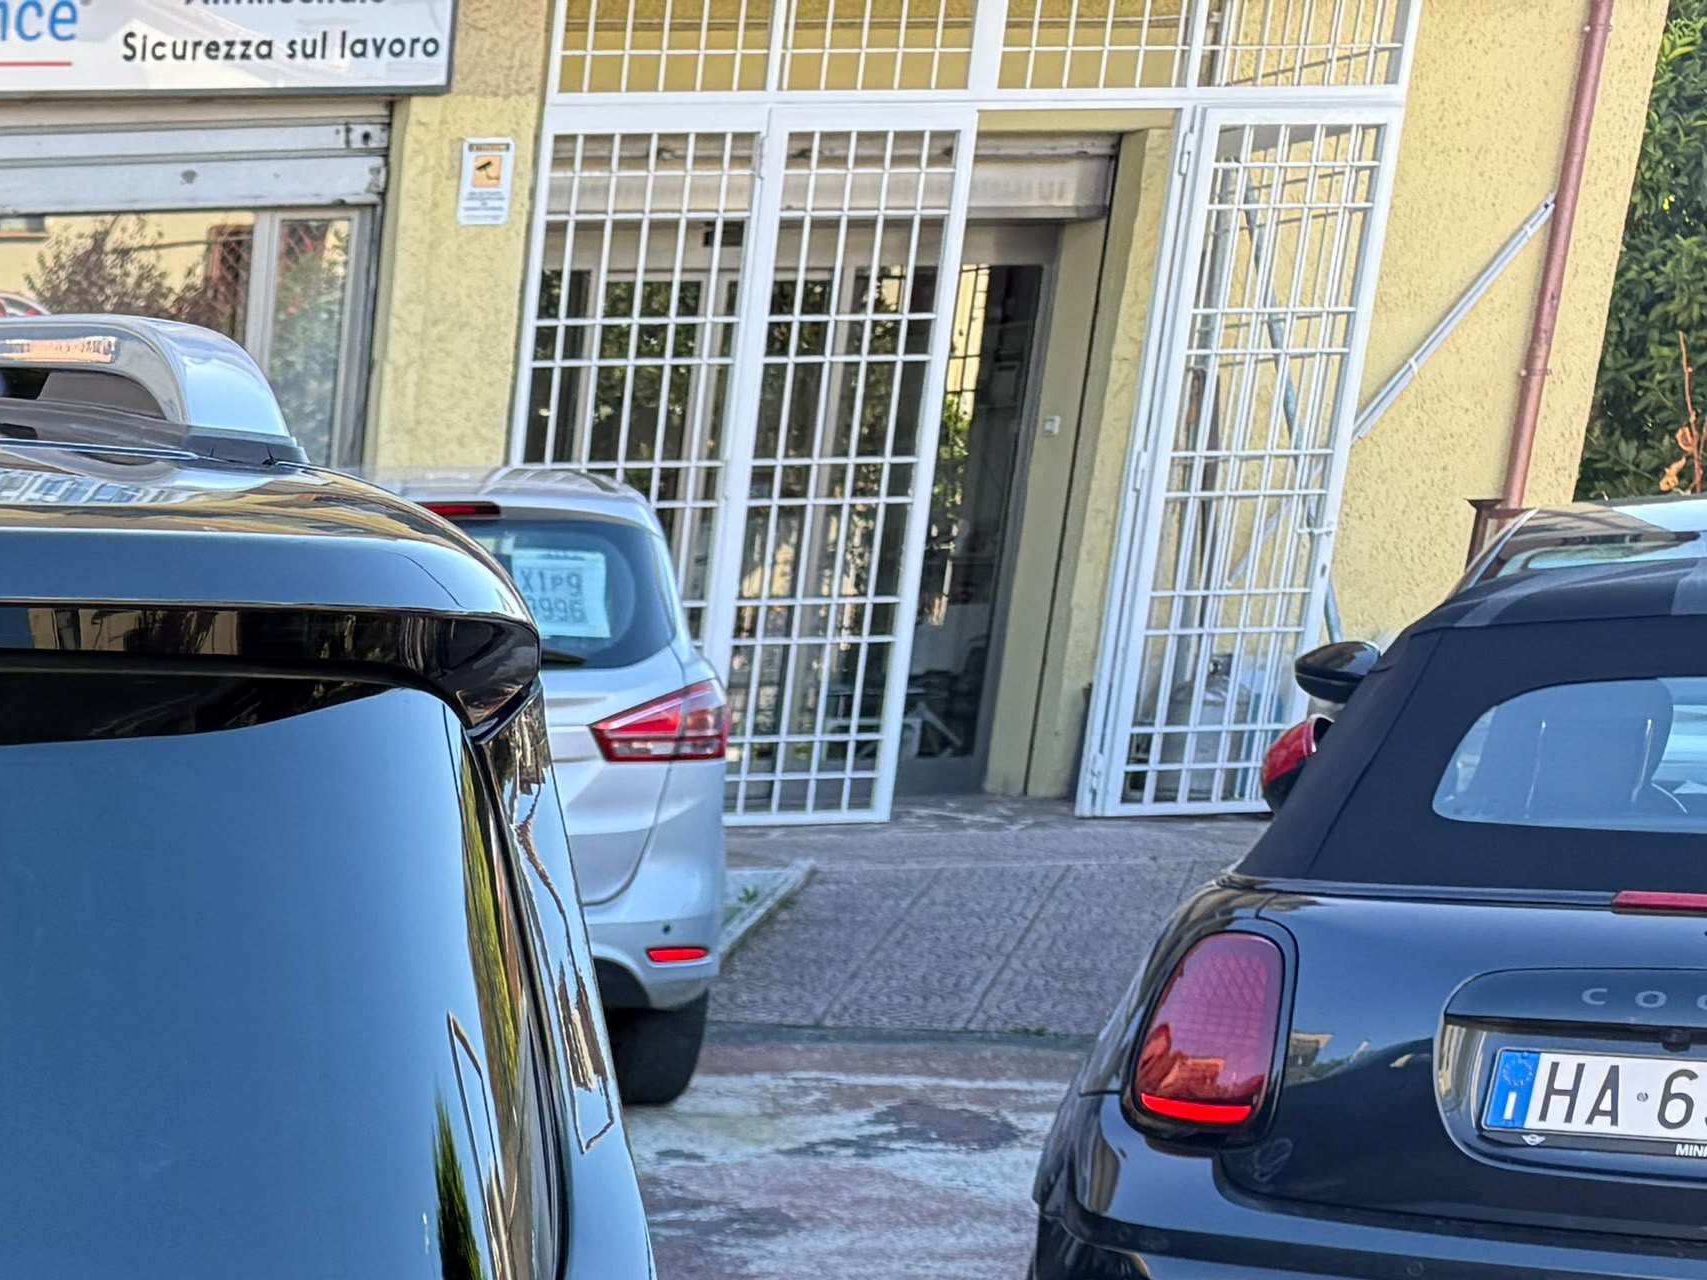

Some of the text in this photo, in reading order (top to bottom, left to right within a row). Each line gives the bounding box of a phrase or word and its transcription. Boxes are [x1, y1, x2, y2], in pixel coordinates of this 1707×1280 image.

[122, 29, 440, 62] Sicurezza sul lavoro
[1538, 1061, 1620, 1127] HA
